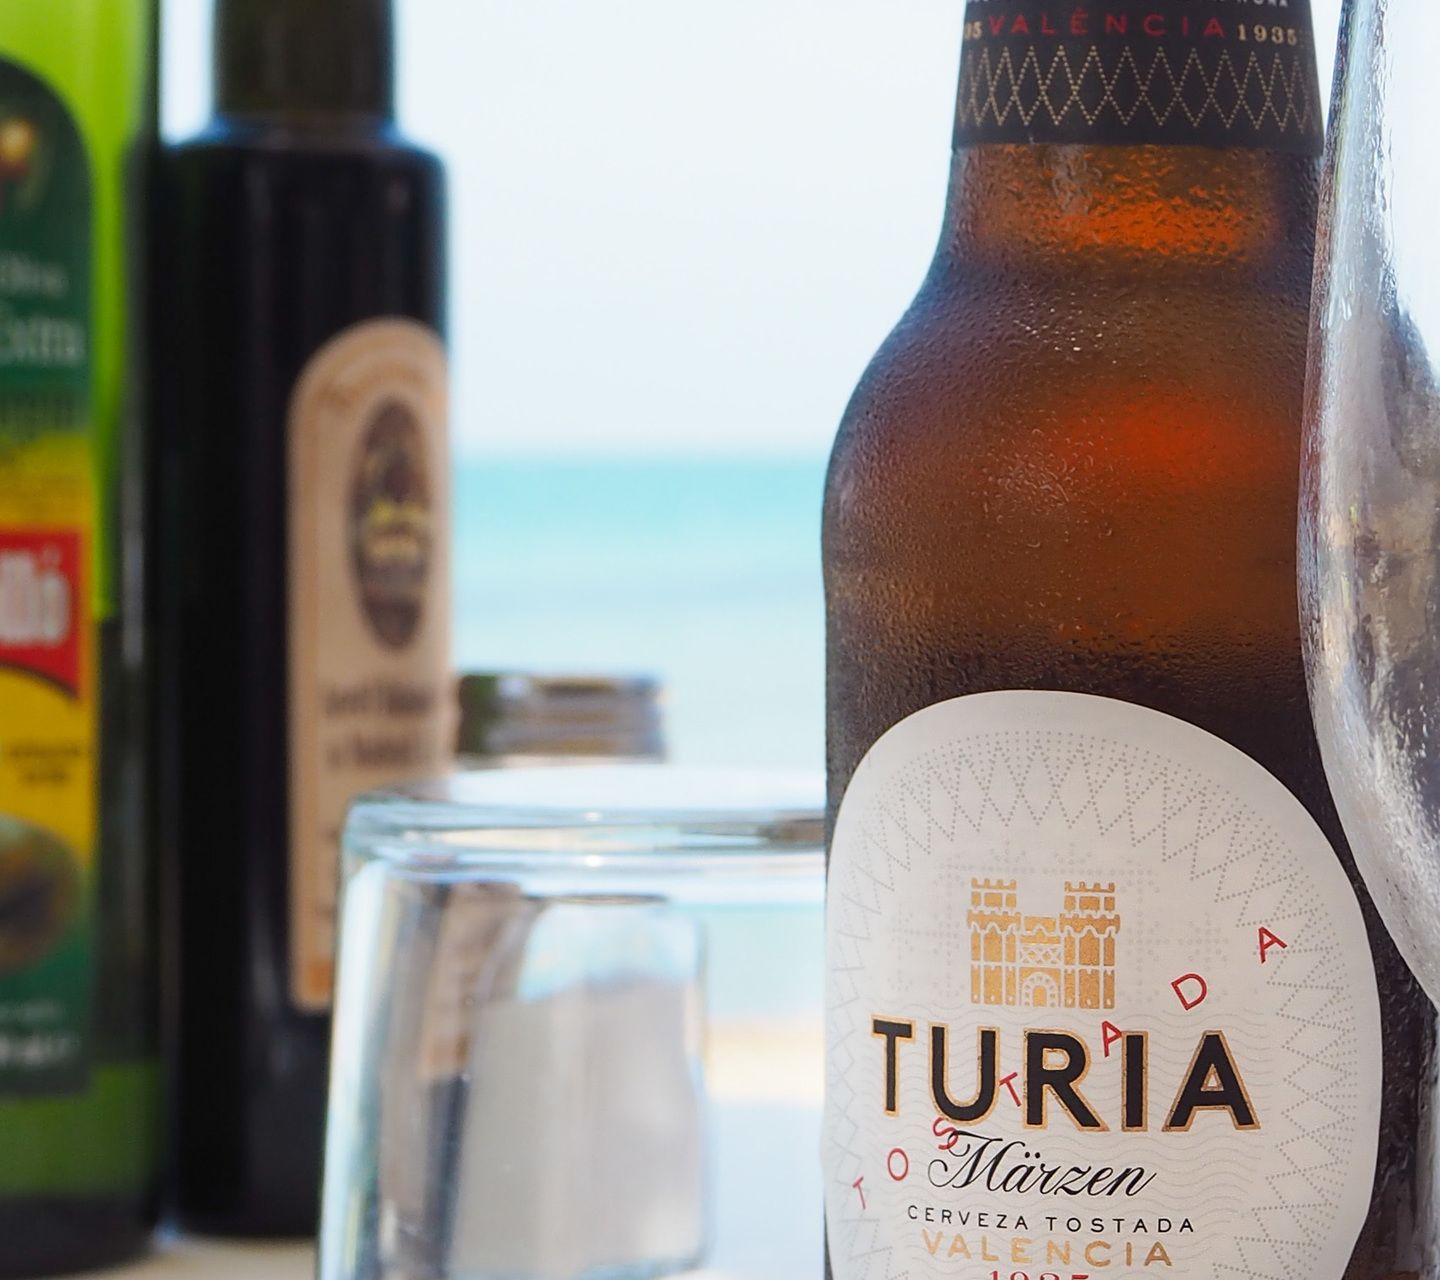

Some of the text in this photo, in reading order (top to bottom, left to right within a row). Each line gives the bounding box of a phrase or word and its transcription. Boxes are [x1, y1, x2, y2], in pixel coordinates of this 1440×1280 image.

[1237, 23, 1298, 46] 1935
[870, 1013, 1261, 1133] TURIA
[927, 1129, 1158, 1197] Märzen
[907, 1204, 1196, 1234] CERVEZA TOSTADA
[921, 1228, 1174, 1268] VALENCIA
